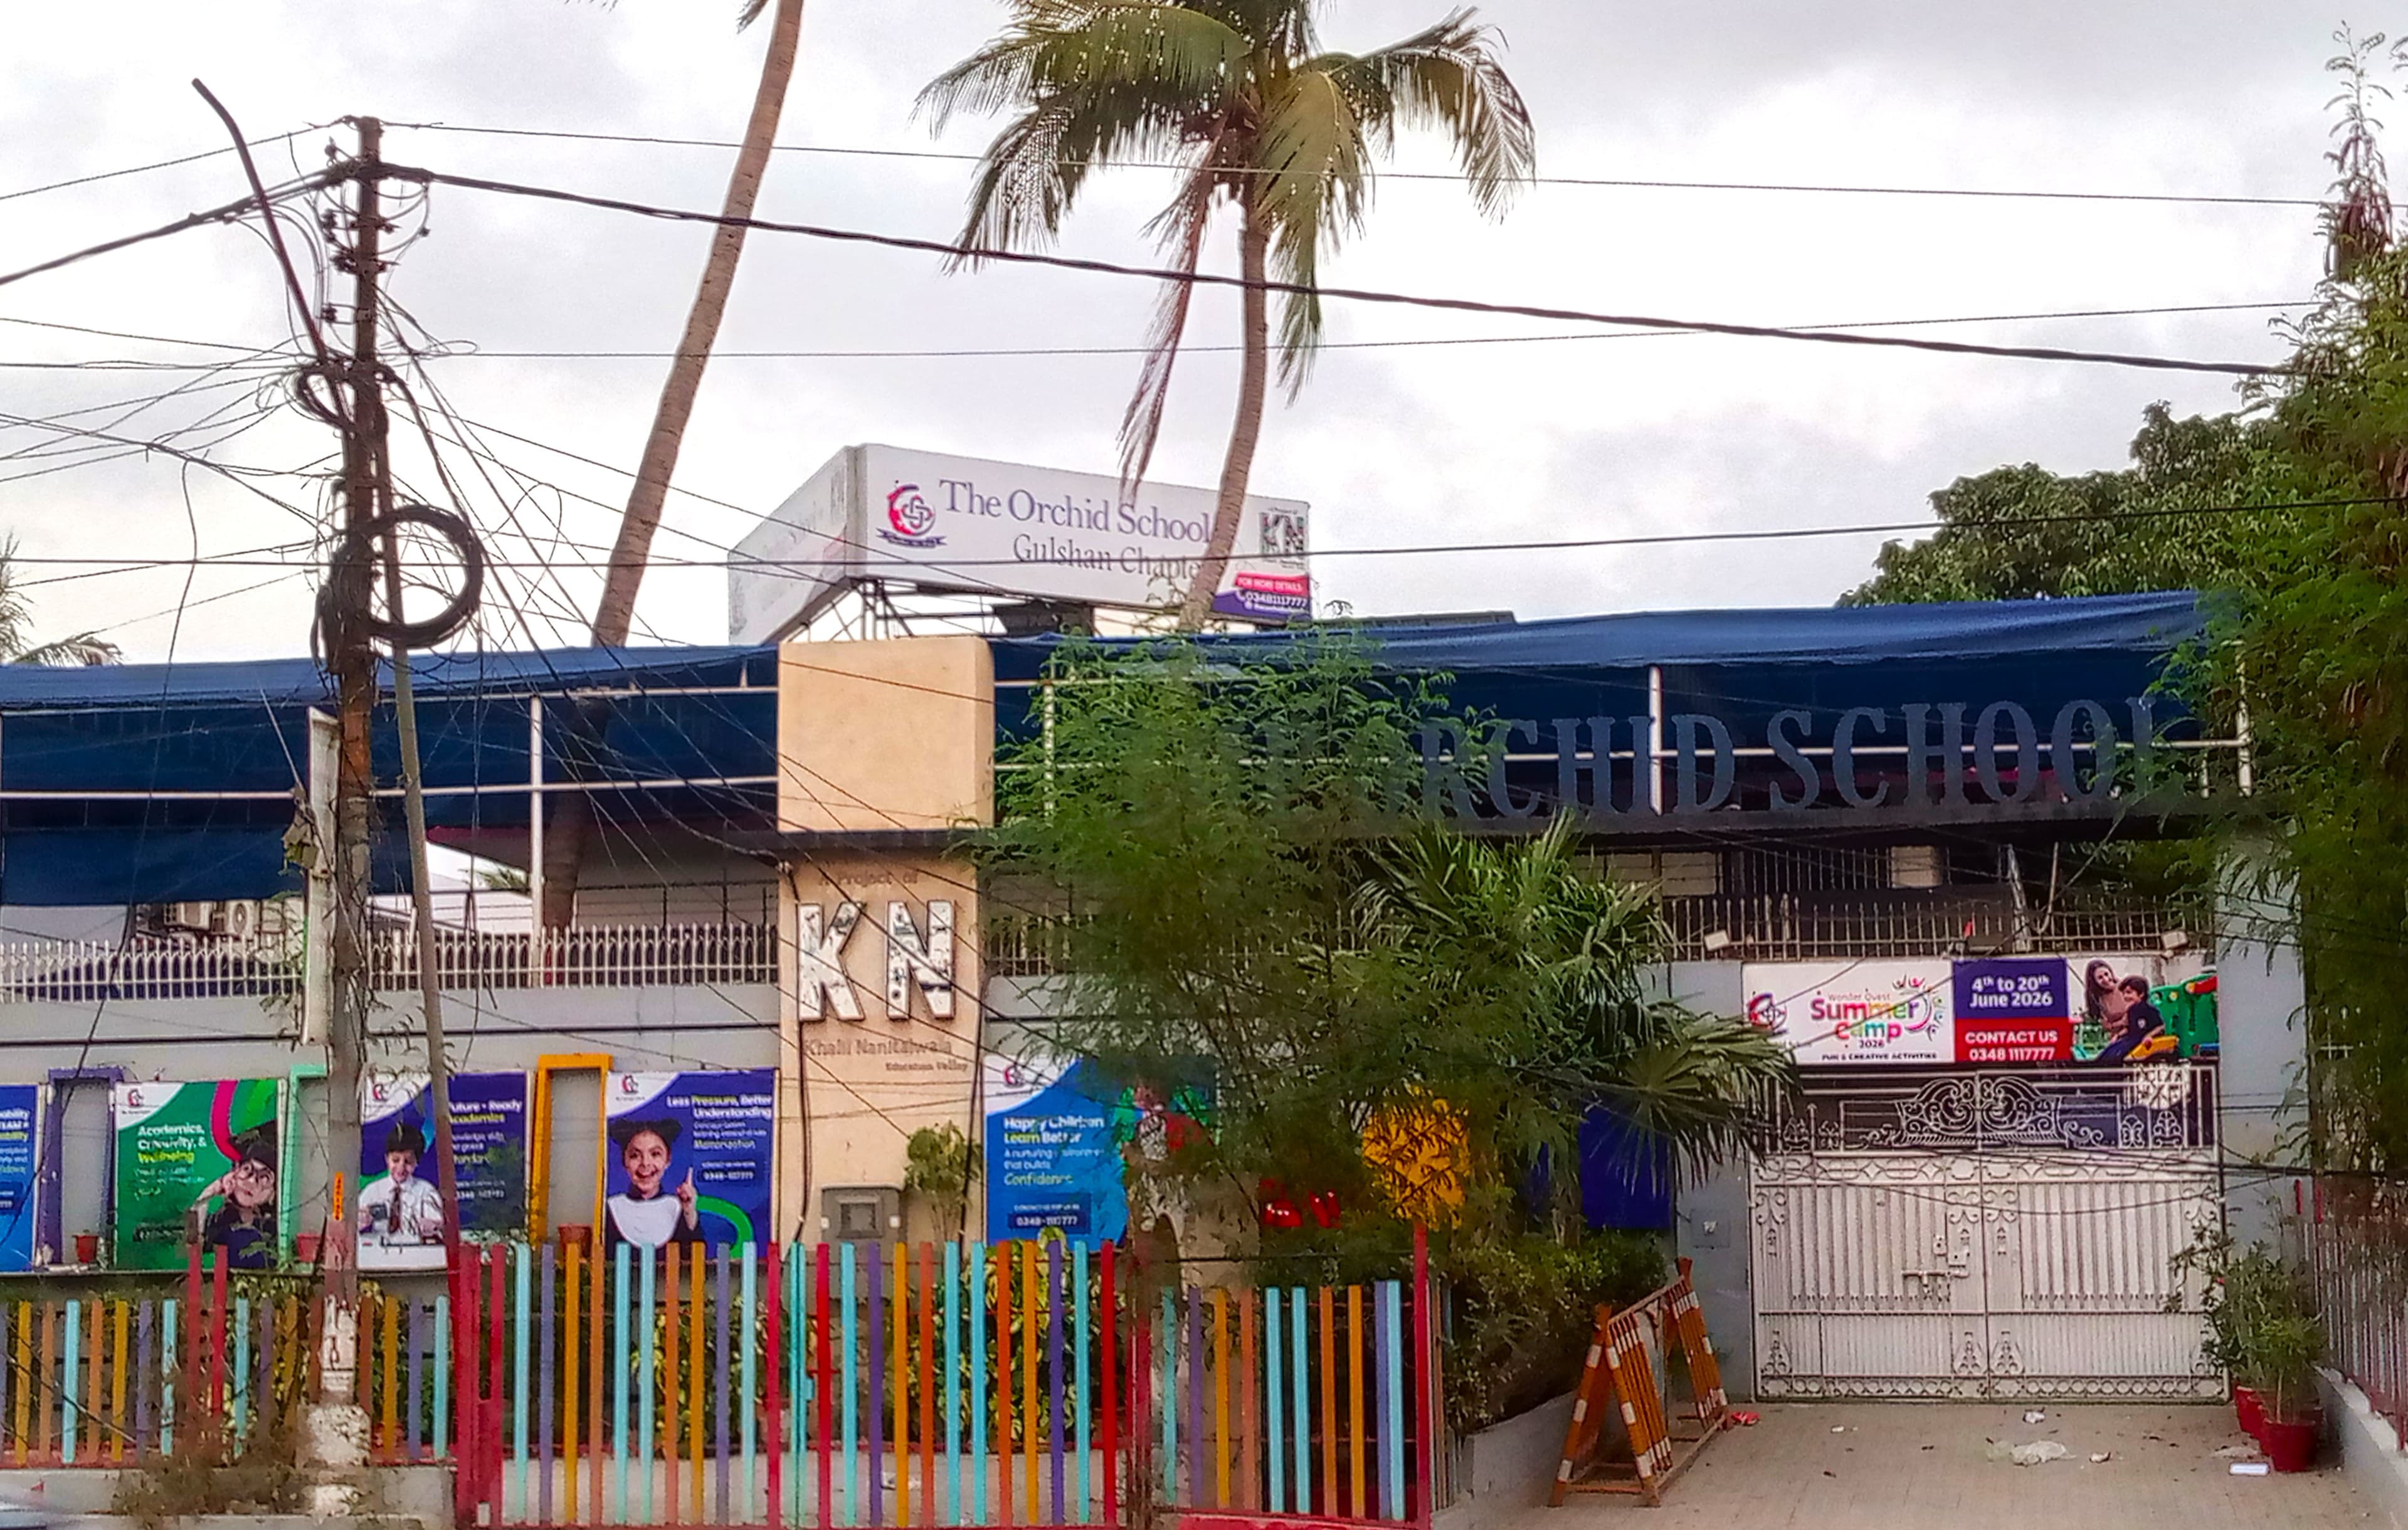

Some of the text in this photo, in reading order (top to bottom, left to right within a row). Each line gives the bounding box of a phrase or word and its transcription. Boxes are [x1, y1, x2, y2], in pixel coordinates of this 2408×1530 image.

[938, 478, 1210, 543] The Orchid School
[1013, 533, 1201, 584] Gulshan Chapte
[1411, 714, 1735, 819] RCHID
[1766, 696, 2176, 811] SCHOOL
[797, 900, 956, 1021] KN
[1972, 975, 2049, 992] 4th to 20th
[1828, 992, 1861, 1001] Wonder
[1970, 991, 2053, 1008] June 2026
[1810, 997, 1920, 1021] Summer
[1859, 1039, 1885, 1049] 2026
[1965, 1030, 2058, 1044] CONTACT US
[1969, 1047, 2056, 1061] 0348 1117777
[448, 1102, 480, 1114] uture
[667, 1095, 690, 1107] Less
[1004, 1132, 1040, 1144] Learn
